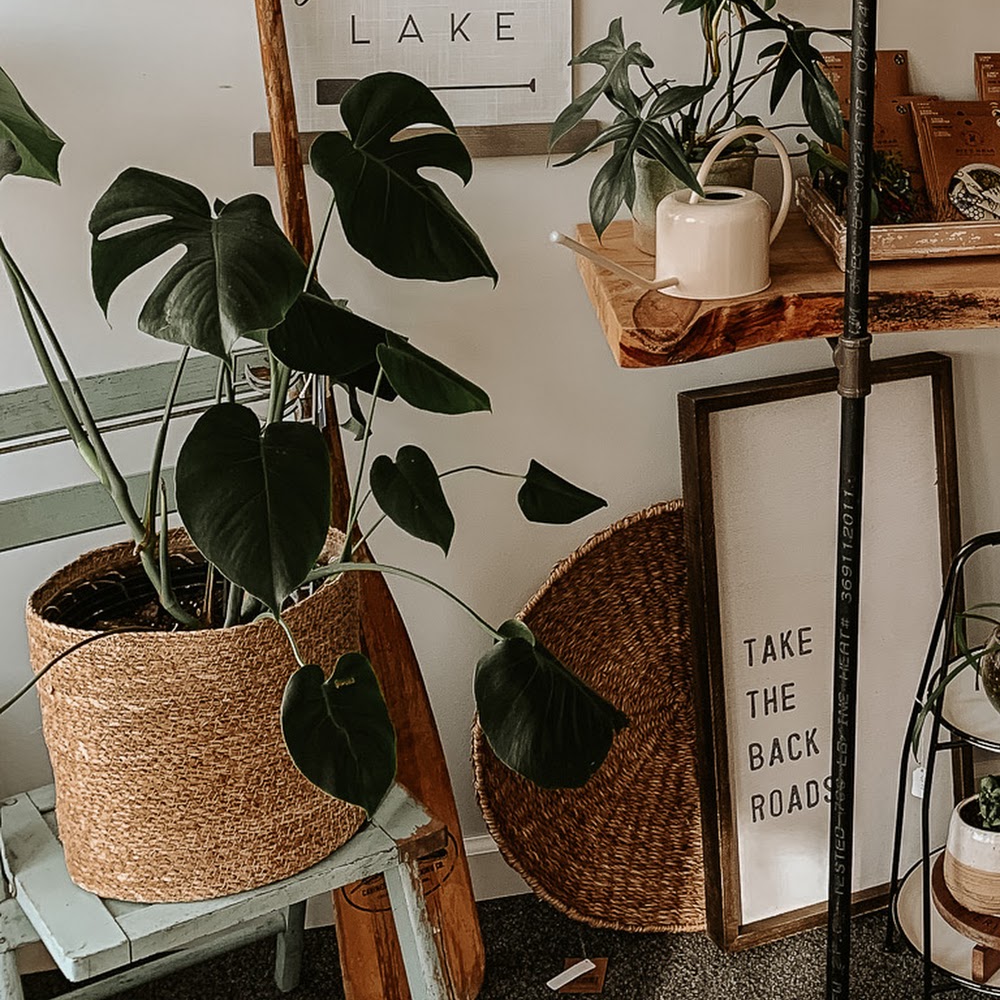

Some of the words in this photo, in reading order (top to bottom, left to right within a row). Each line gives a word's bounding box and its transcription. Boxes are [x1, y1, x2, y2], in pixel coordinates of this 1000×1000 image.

[351, 11, 516, 44] LAKE
[743, 627, 813, 667] TAKE
[746, 682, 796, 719] THE
[748, 728, 820, 771] BACK
[751, 776, 833, 823] ROADS
